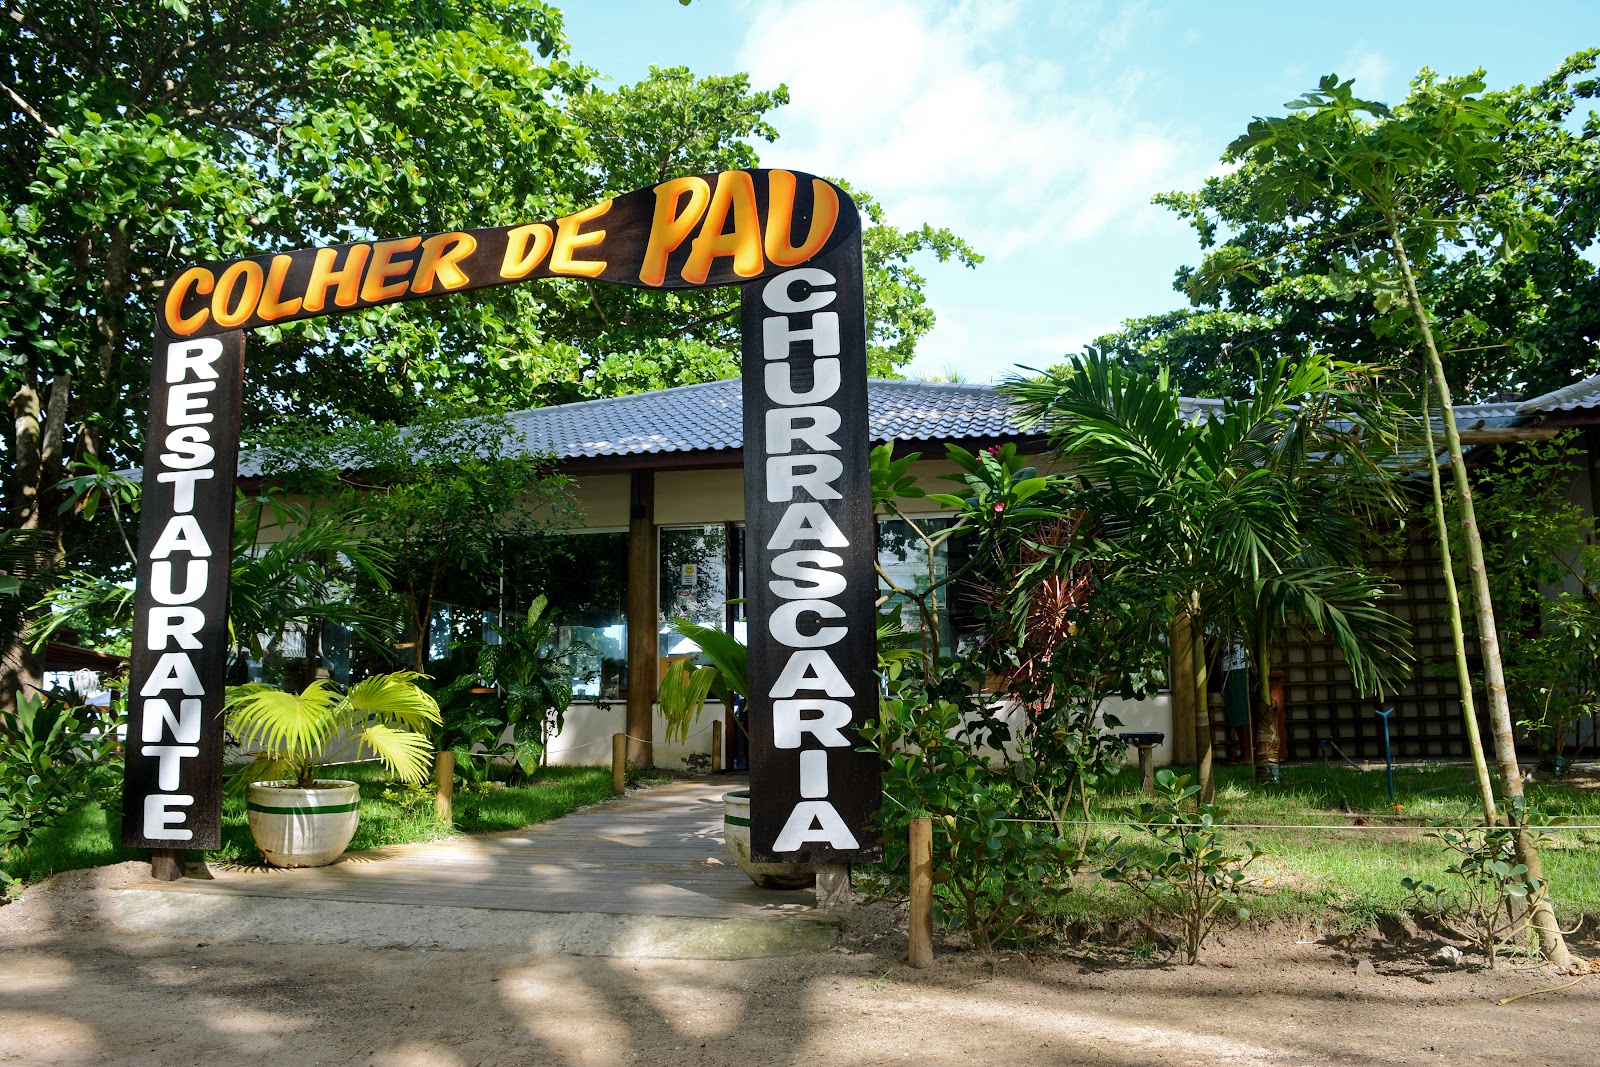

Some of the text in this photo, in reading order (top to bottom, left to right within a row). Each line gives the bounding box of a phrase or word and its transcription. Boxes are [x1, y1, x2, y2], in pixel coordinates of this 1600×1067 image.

[164, 170, 840, 336] COLHER DE PAU
[142, 338, 224, 841] RESTAURANTE
[762, 267, 860, 853] CHURRASCARIA
